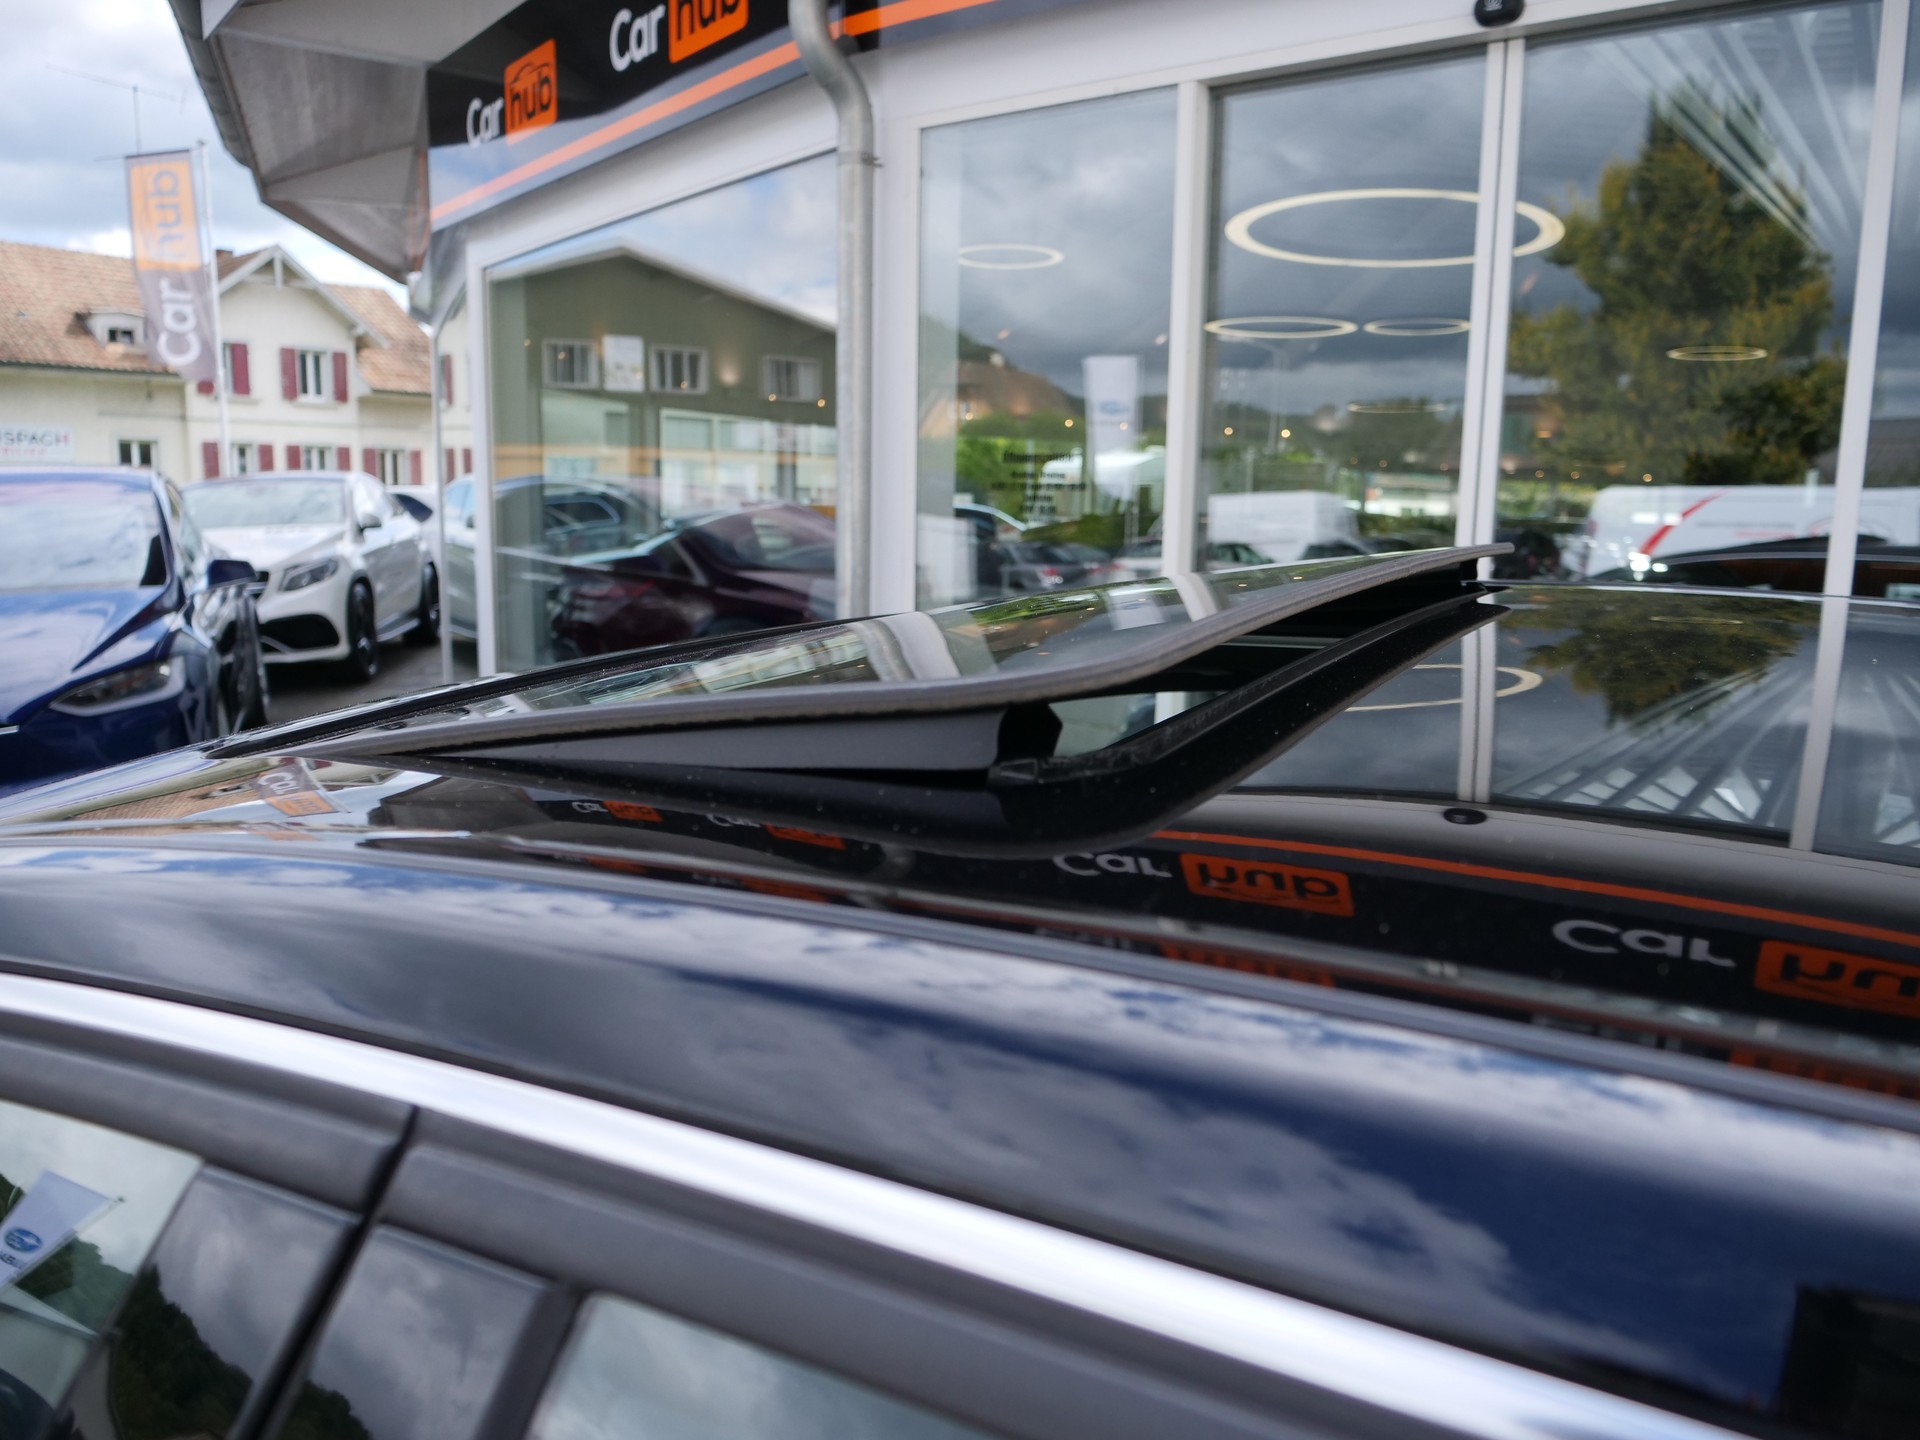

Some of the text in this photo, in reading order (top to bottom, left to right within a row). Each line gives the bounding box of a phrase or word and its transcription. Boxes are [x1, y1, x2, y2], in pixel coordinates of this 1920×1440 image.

[609, 4, 666, 72] Car
[466, 67, 552, 148] Car hub
[149, 169, 202, 366] Car hub
[0, 430, 70, 447] SPACH
